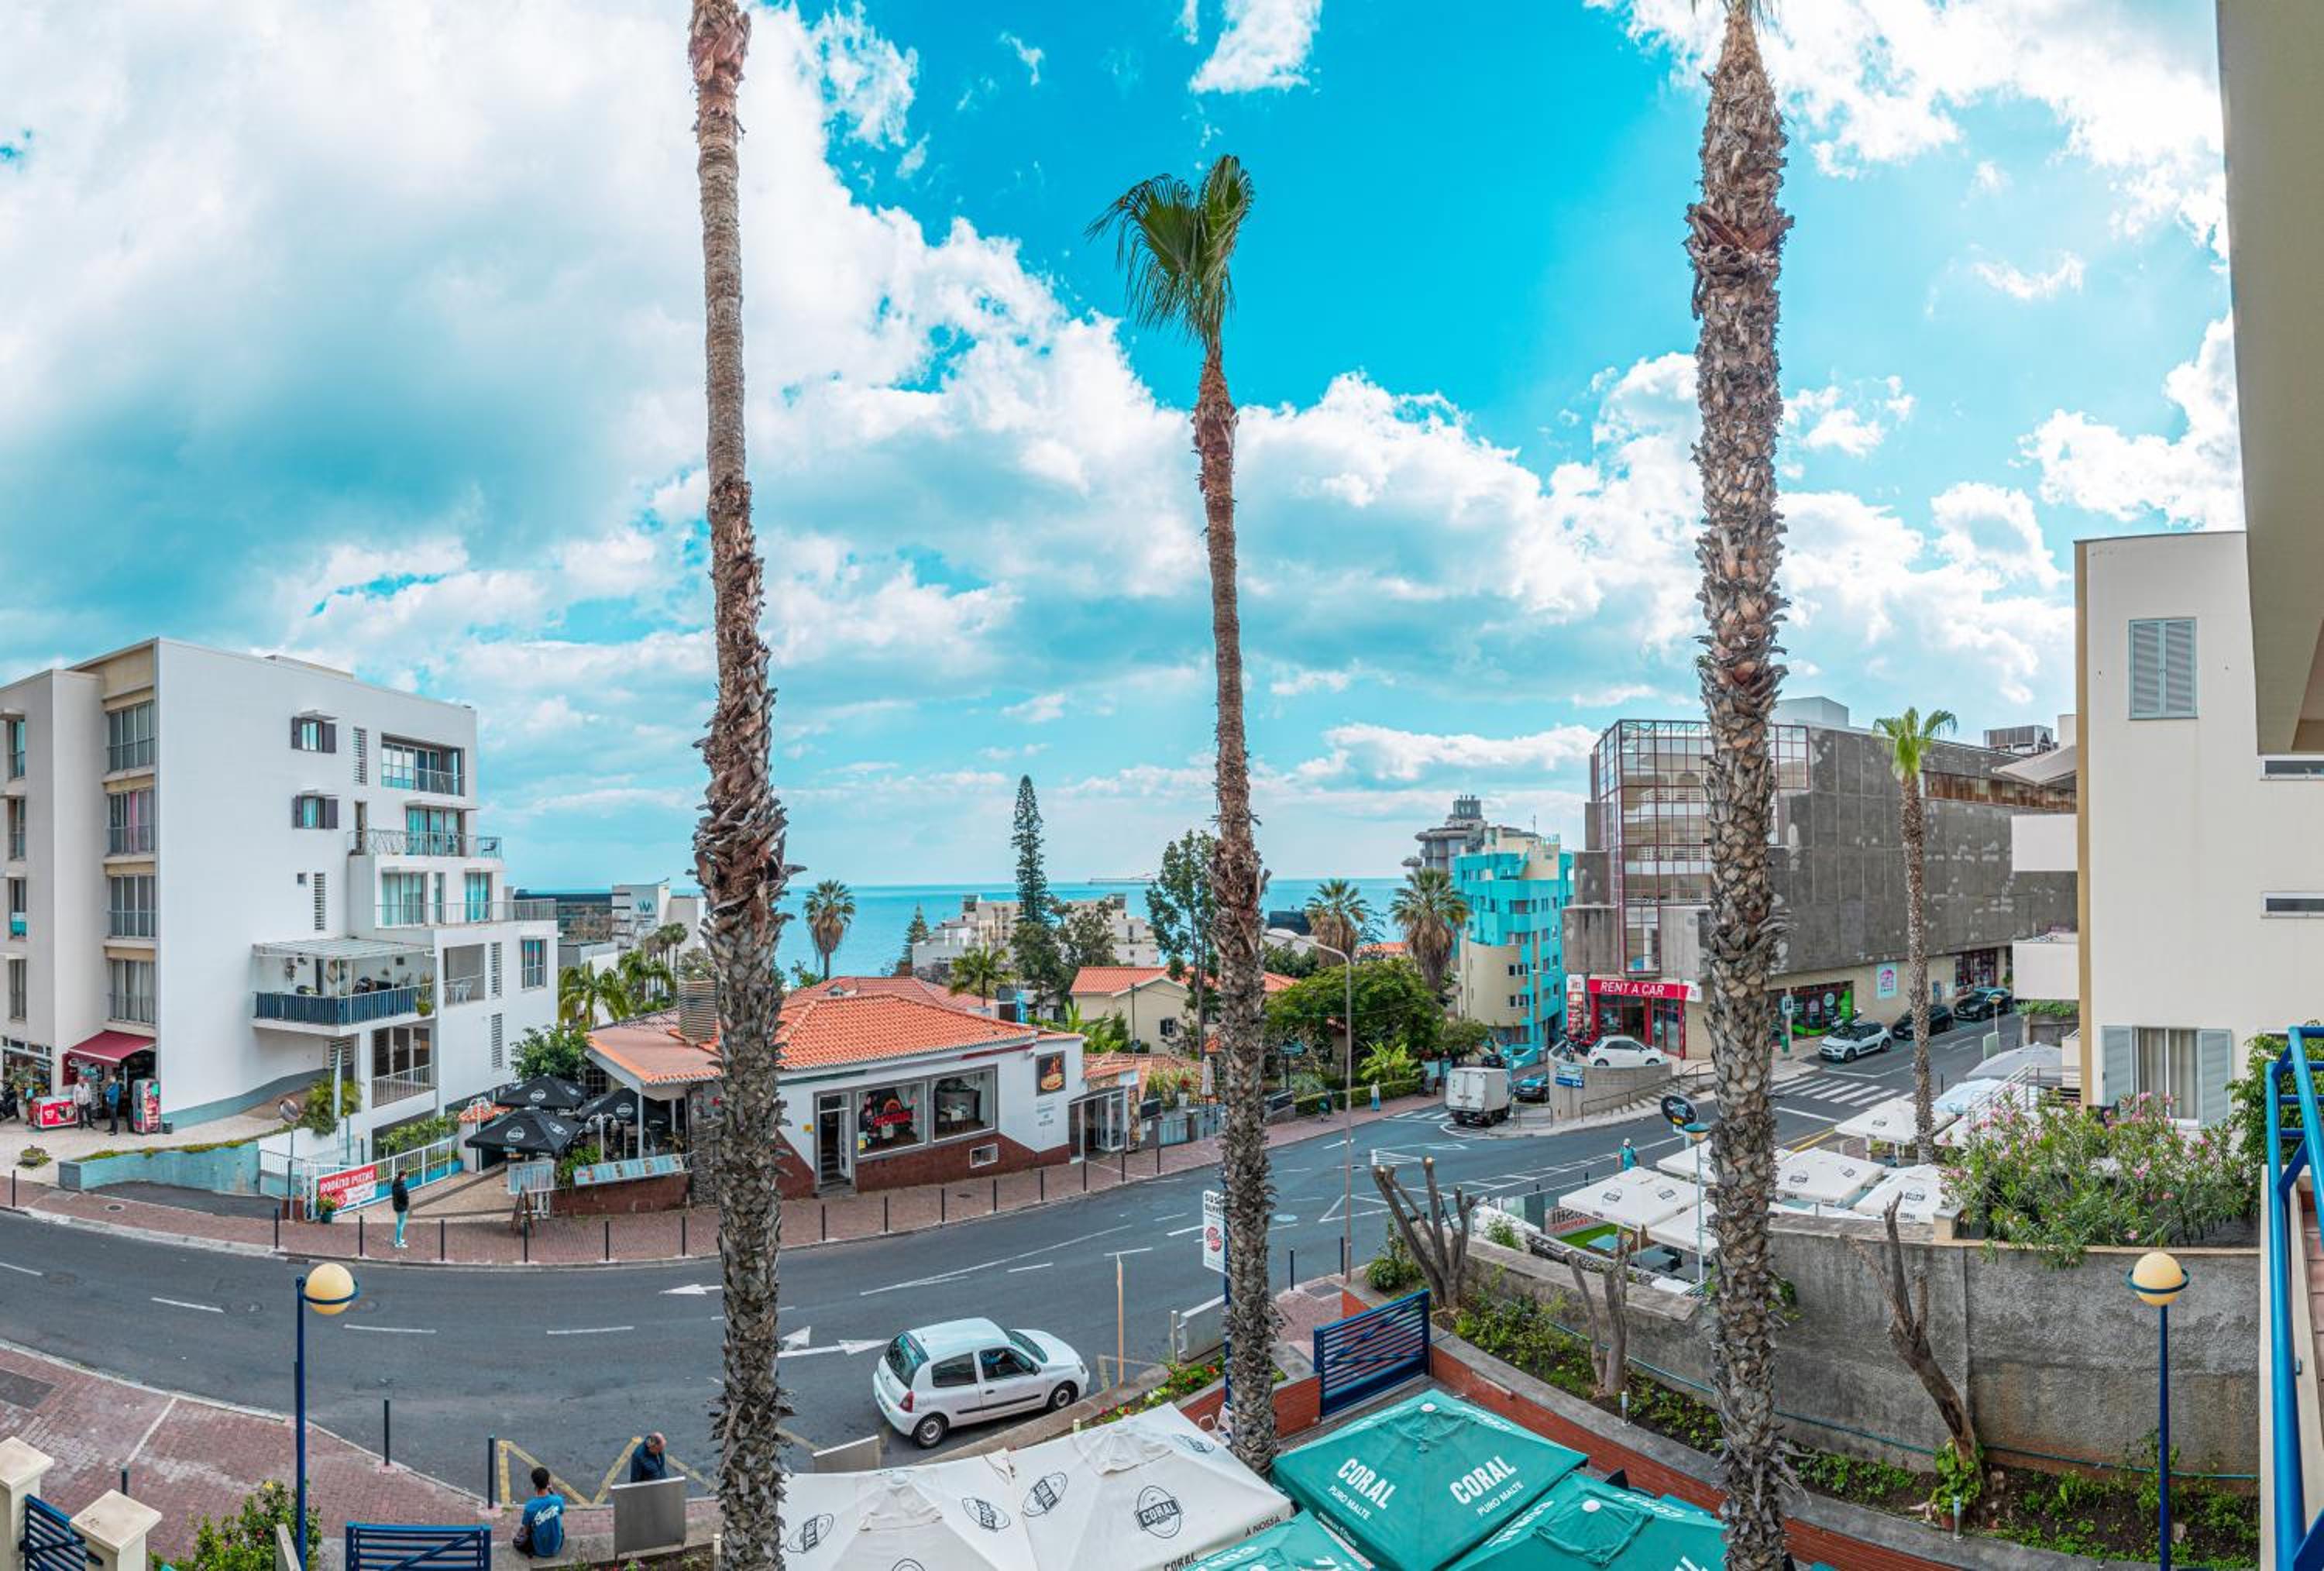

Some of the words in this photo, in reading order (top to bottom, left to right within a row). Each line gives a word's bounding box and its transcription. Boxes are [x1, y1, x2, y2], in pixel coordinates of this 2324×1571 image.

[1600, 981, 1630, 994] RENT
[1631, 984, 1638, 994] A
[1642, 984, 1665, 996] CAR
[1338, 1458, 1396, 1511] CORAL
[1450, 1456, 1517, 1504] CORAL
[1141, 1502, 1177, 1524] CORAL
[1328, 1485, 1348, 1503] PURO
[1346, 1498, 1372, 1521] MALTE
[1477, 1498, 1501, 1518] PURO
[1499, 1480, 1525, 1503] MALTE
[1164, 1552, 1195, 1571] CORAL
